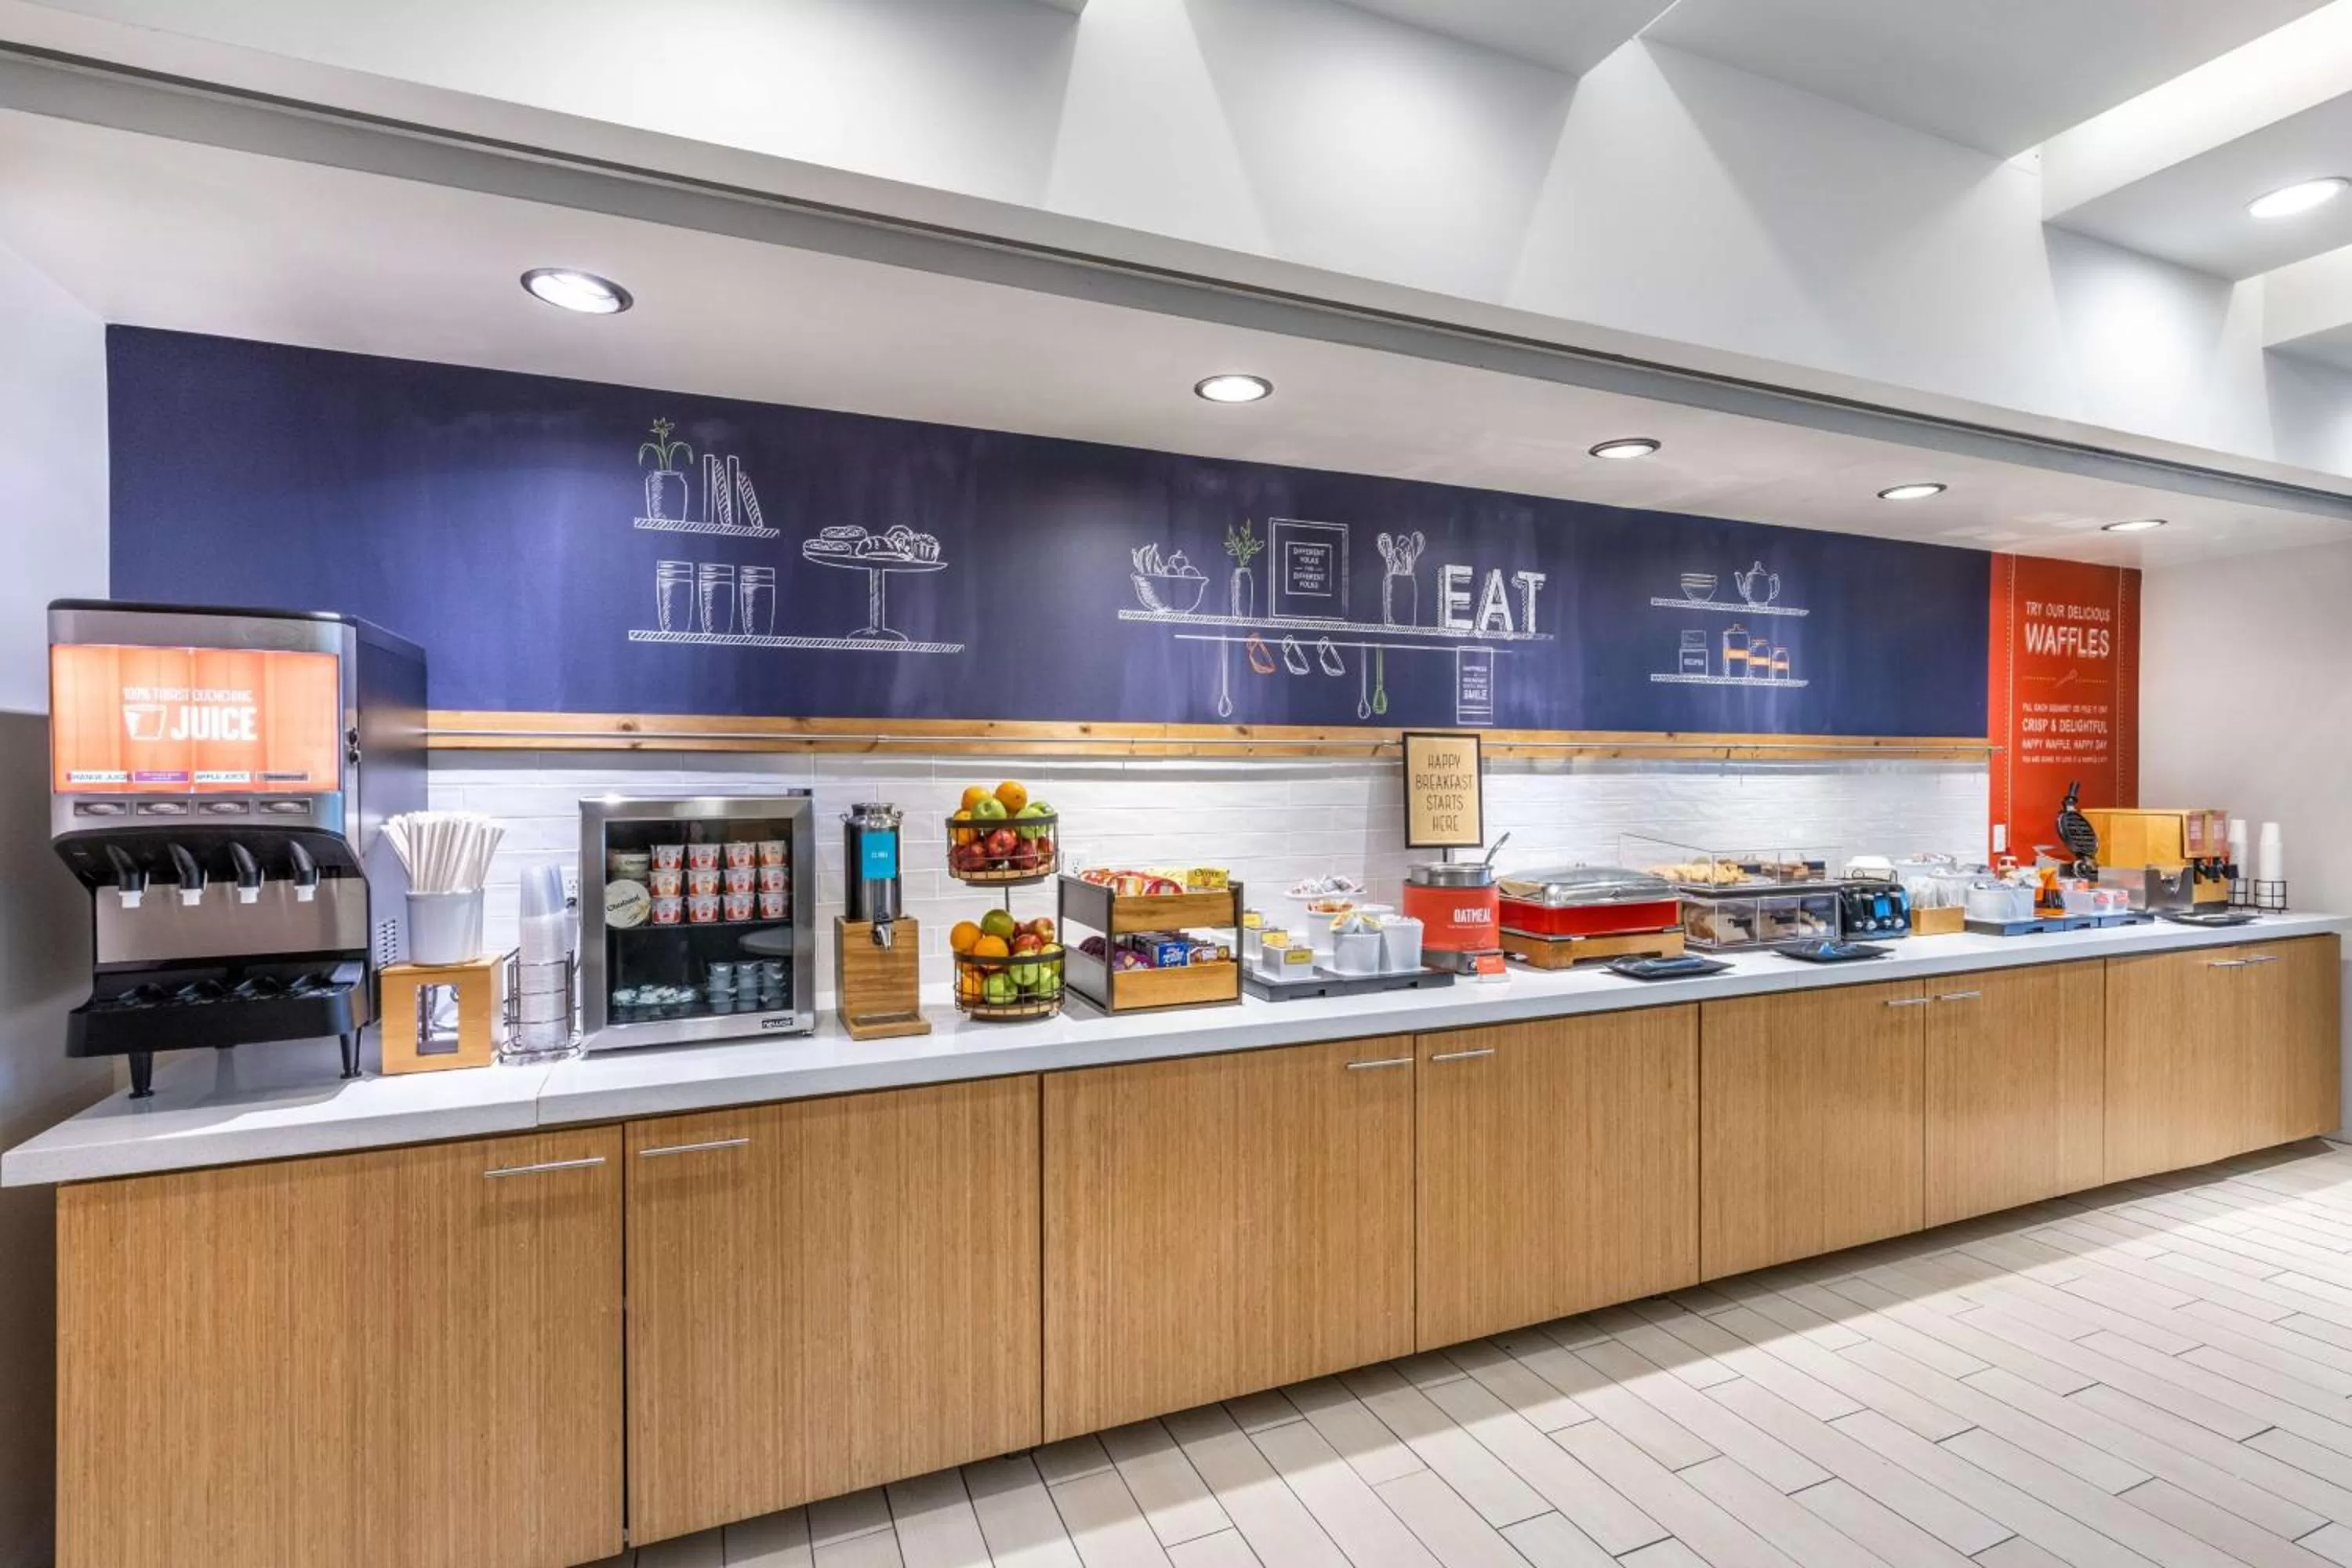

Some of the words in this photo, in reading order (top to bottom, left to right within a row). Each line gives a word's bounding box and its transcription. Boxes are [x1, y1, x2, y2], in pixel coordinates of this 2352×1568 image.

[1438, 564, 1547, 633] EAT
[2025, 601, 2043, 616] TRY
[2045, 603, 2065, 619] OUR
[2067, 604, 2111, 622] DELICIOUS
[2025, 622, 2111, 659] WAFFLES
[171, 705, 258, 741] JUICE
[2022, 718, 2048, 732] CRISP
[2059, 718, 2108, 735] DELIGHTFUL
[2022, 739, 2043, 750] HAPPY
[2074, 739, 2094, 750] HAPPY
[2096, 739, 2108, 750] DAY
[1427, 753, 1461, 769] HAPPY
[1415, 773, 1474, 791] BREAKFAST
[1426, 793, 1464, 811] STARTS
[1432, 814, 1460, 832] HERE
[1454, 906, 1491, 924] OATMEAL
